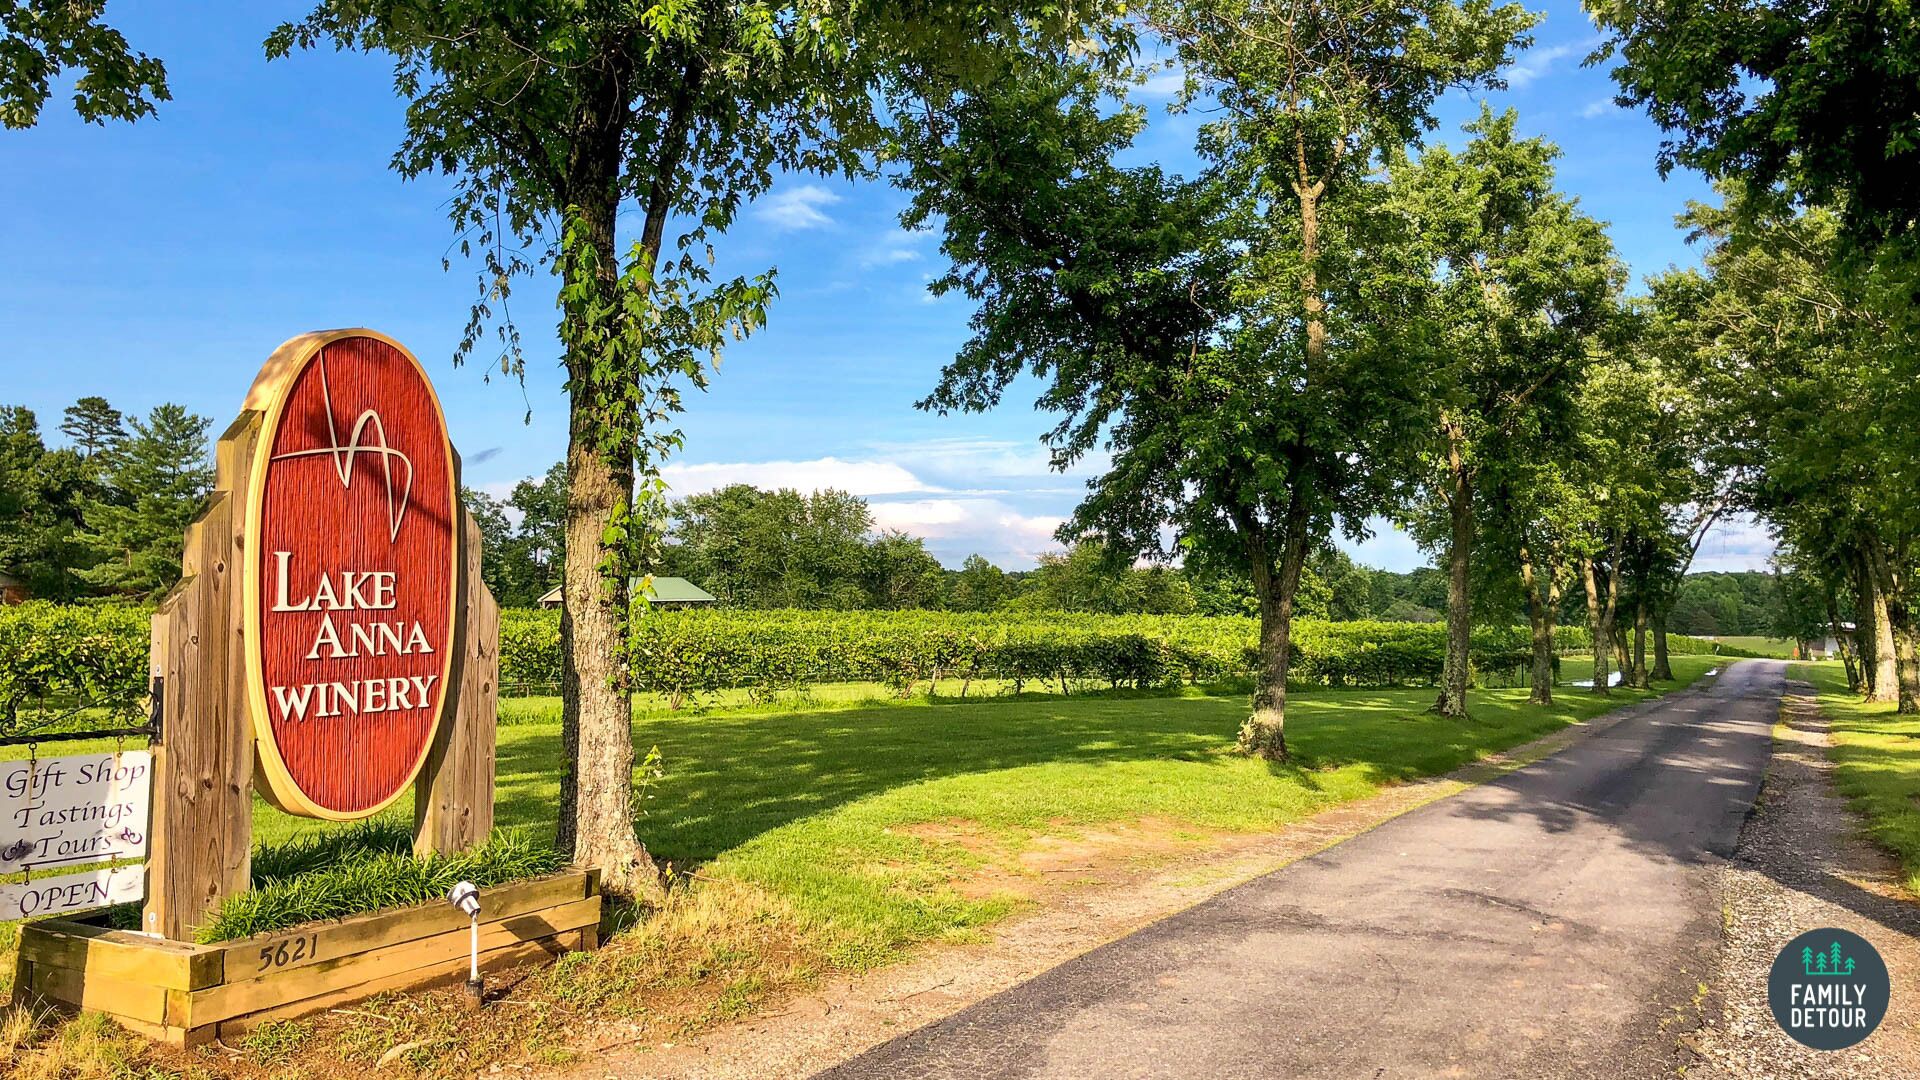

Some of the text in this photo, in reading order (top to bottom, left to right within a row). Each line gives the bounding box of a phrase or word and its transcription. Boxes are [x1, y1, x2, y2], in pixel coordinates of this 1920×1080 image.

[272, 551, 397, 612] LAKE
[305, 613, 434, 660] ANNA
[271, 674, 439, 721] WINERY
[6, 757, 145, 799] Gift Shop
[13, 800, 134, 829] Tastings
[33, 830, 113, 858] Tours
[19, 874, 113, 914] OPEN
[257, 933, 318, 972] 5621
